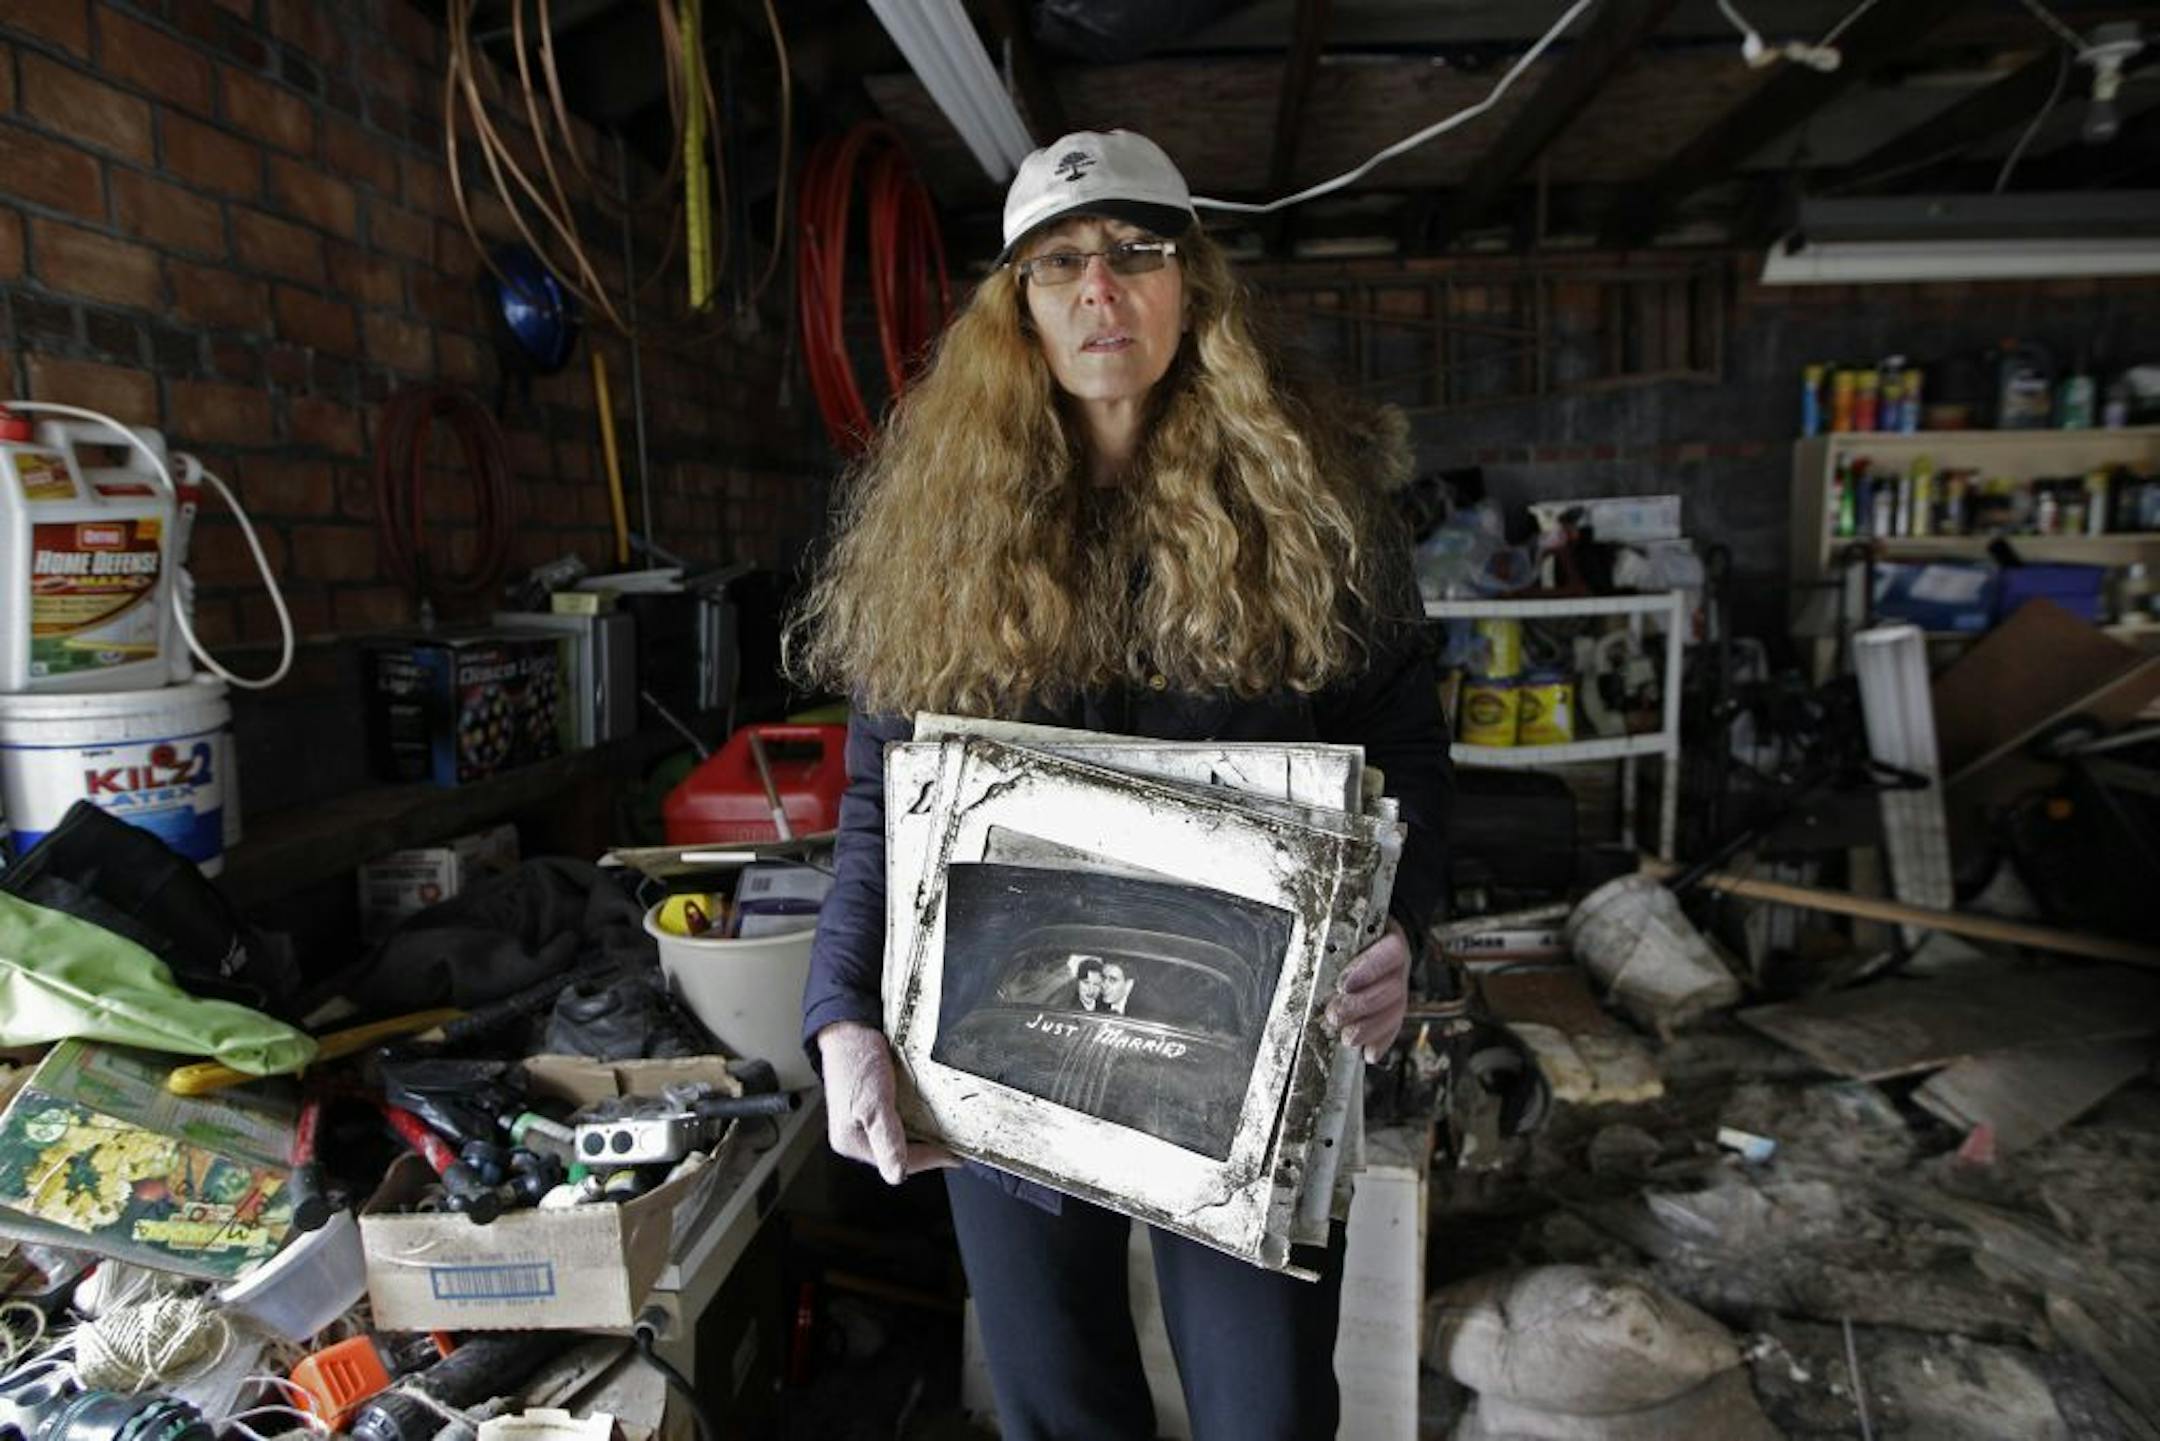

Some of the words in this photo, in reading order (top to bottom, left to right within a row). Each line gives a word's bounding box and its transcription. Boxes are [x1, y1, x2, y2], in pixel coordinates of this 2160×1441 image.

[34, 551, 91, 575] HOME
[1025, 1013, 1079, 1037] JUST
[1094, 1025, 1187, 1058] MARRIED
